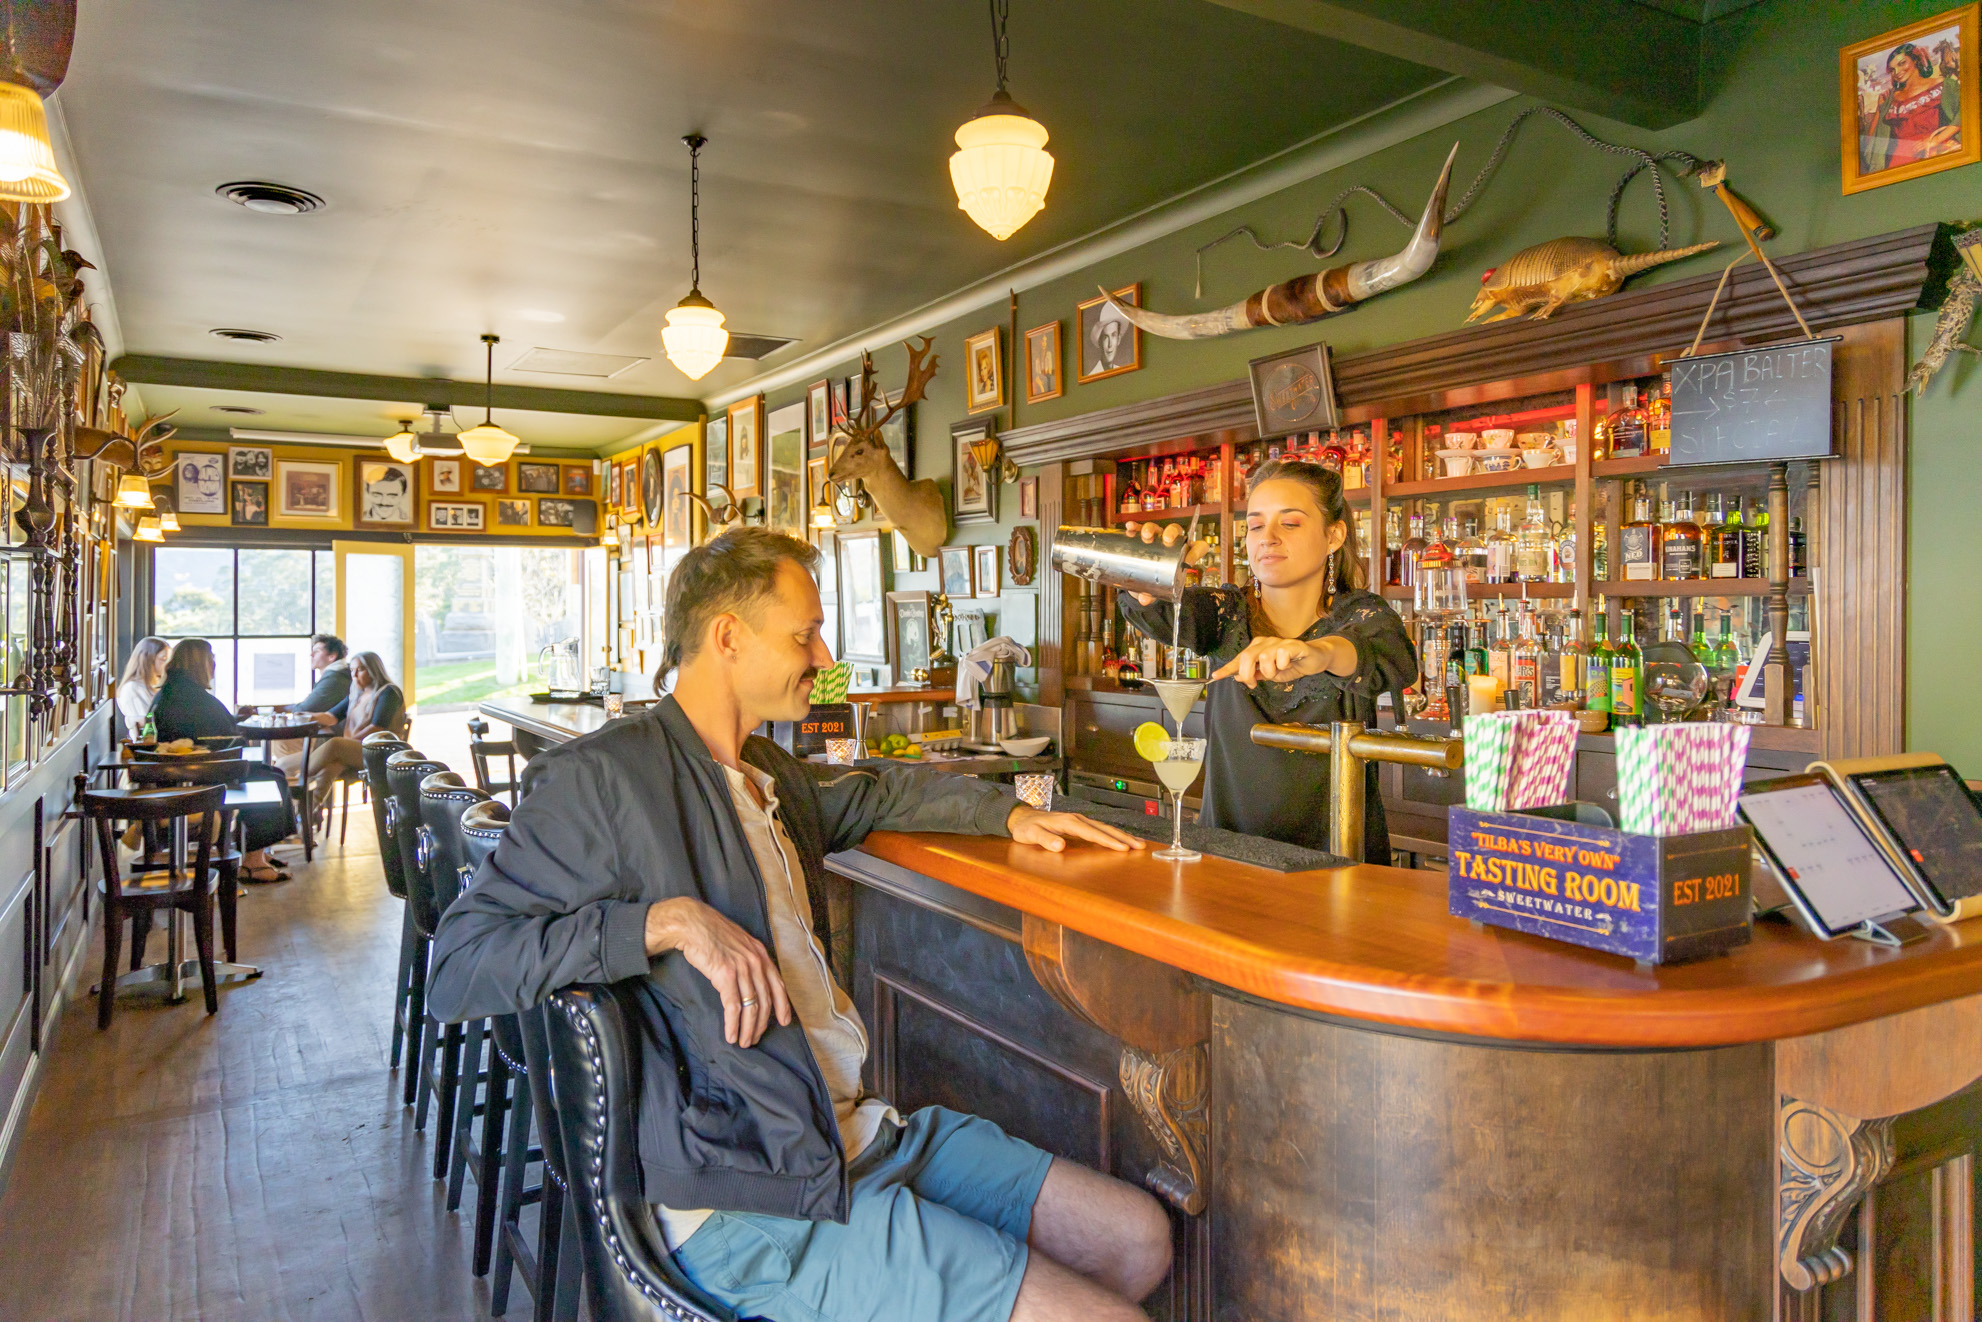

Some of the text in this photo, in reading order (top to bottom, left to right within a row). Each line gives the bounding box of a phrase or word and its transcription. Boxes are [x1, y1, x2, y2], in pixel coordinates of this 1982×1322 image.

[1674, 347, 1827, 394] XPA BALTER
[801, 721, 844, 734] EST 2021
[1471, 832, 1621, 871] "TILBA'S VERY OWN"
[1455, 850, 1641, 912] TASTING ROOM
[1673, 872, 1740, 907] EST 2021
[1497, 890, 1593, 921] SWEETWATER
